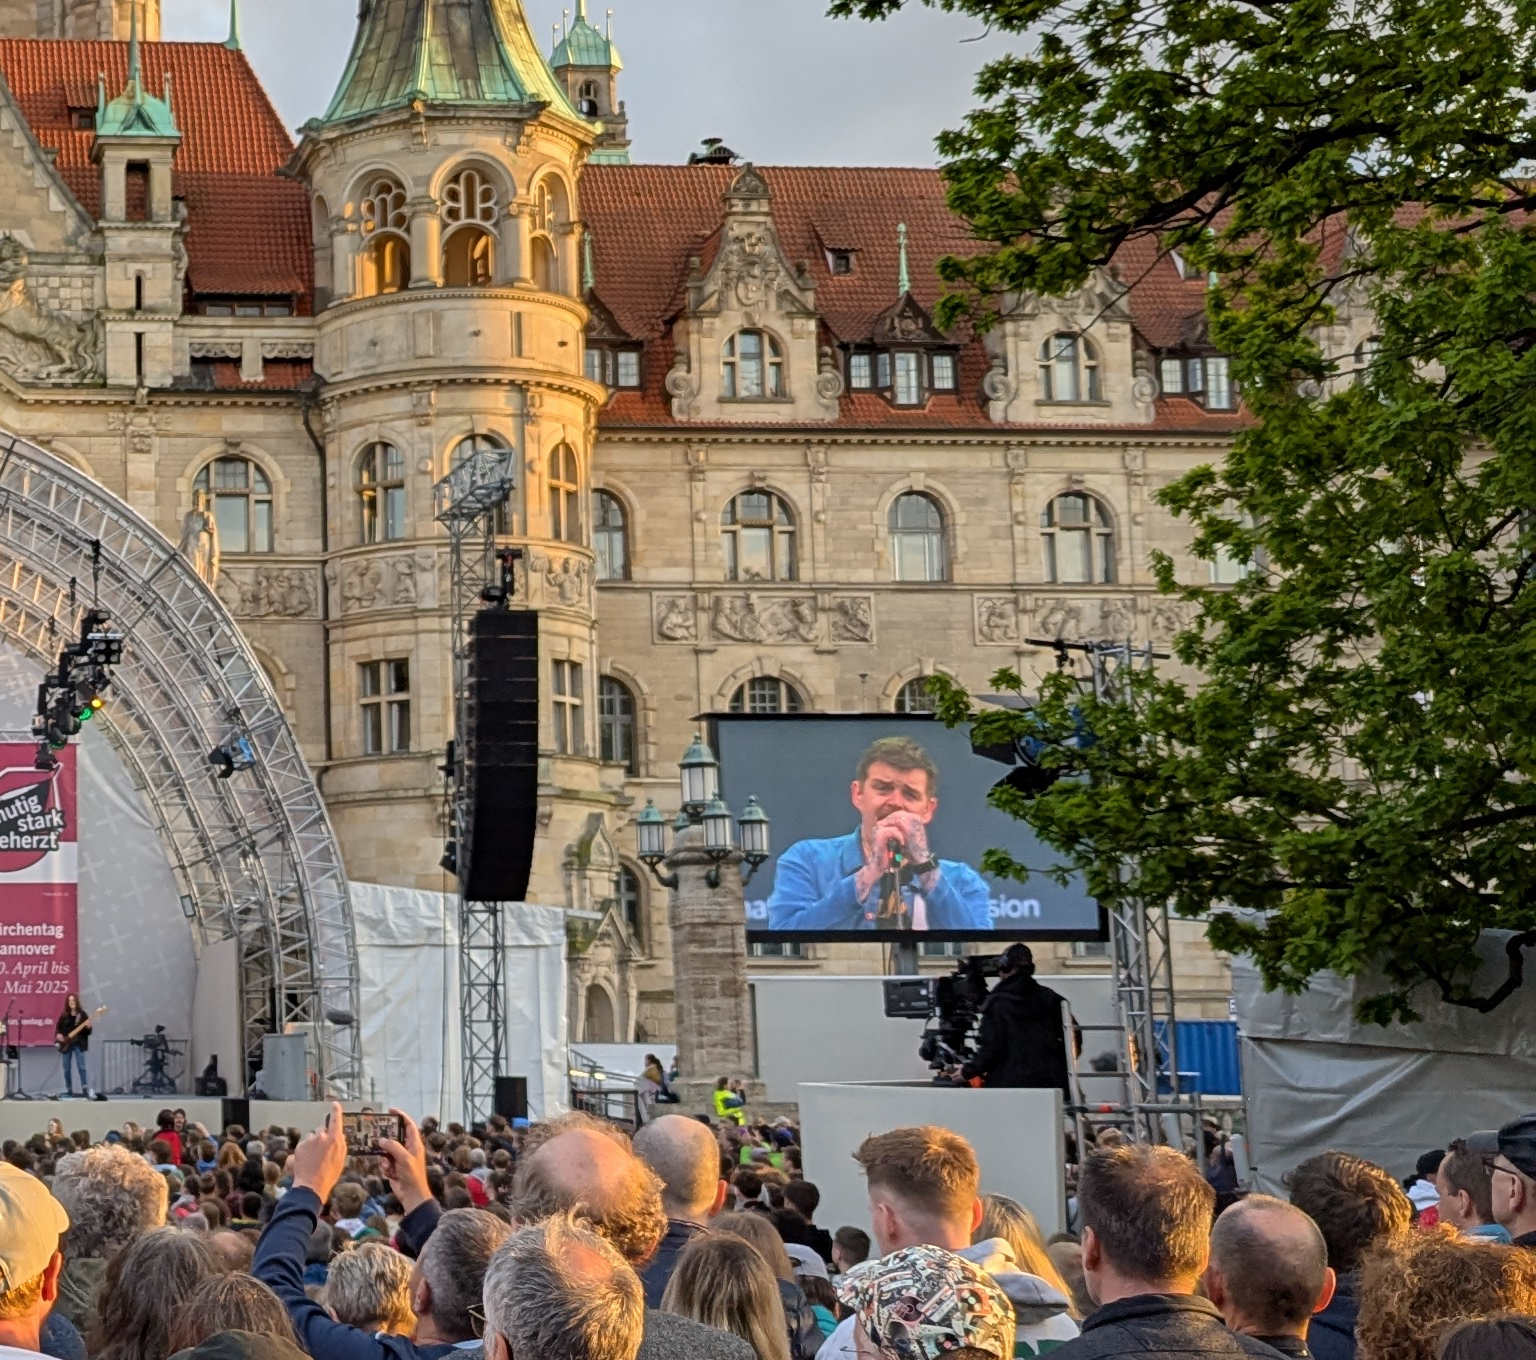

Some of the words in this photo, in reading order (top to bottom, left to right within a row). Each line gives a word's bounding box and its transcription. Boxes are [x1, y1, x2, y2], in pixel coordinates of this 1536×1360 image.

[17, 809, 64, 832] stark
[12, 961, 47, 978] April
[51, 962, 70, 975] bis
[3, 981, 32, 994] Mai
[35, 981, 69, 994] 2025
